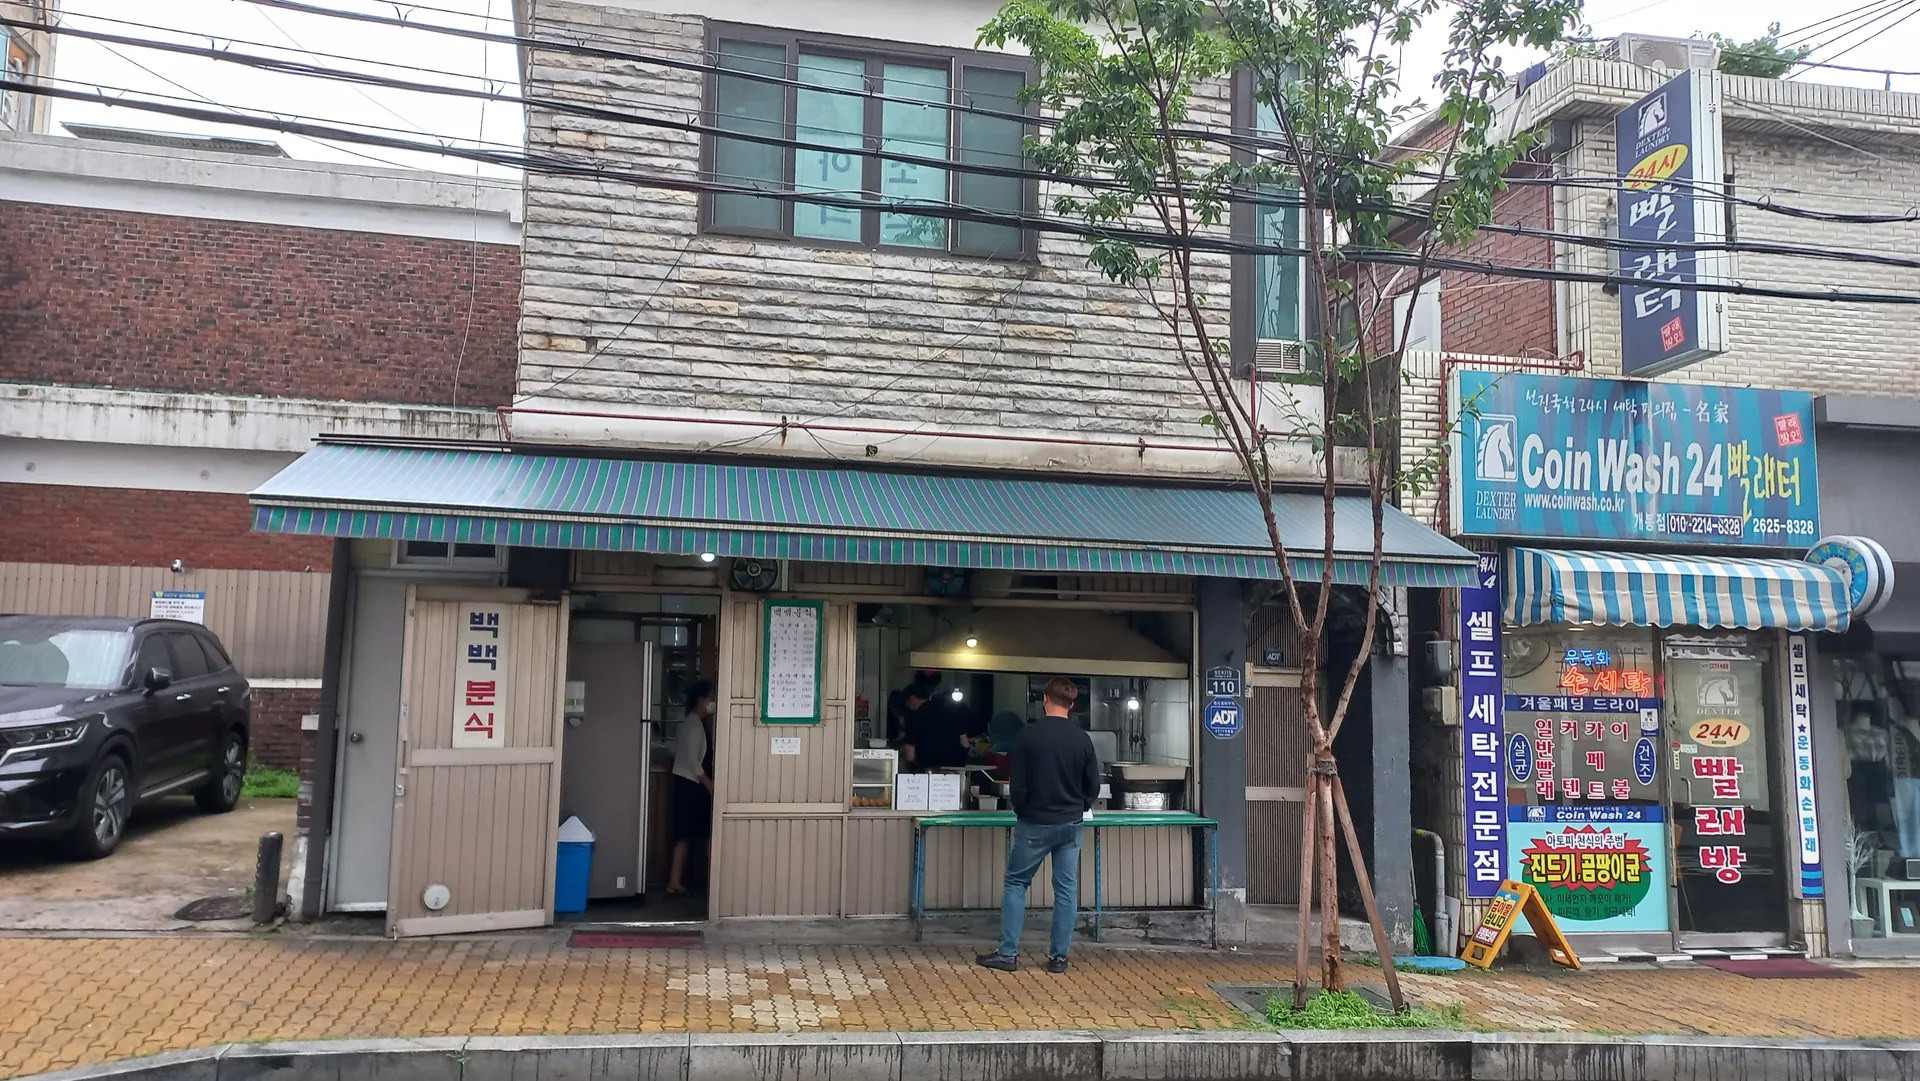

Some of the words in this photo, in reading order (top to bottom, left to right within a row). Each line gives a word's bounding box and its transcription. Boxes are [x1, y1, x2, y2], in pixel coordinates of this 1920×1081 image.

[1635, 133, 1671, 158] LAUNDRY
[1636, 127, 1668, 150] DEXTER
[1579, 399, 1607, 414] 24시
[1613, 399, 1638, 418] 세탁
[1521, 432, 1591, 492] Coin
[1598, 438, 1680, 495] Wash
[1686, 443, 1724, 497] 24
[1727, 440, 1800, 522] 빨래터
[1475, 490, 1517, 508] DEXTER
[1524, 493, 1625, 512] www.coinwash.co.kr
[1475, 507, 1517, 521] LAUNDRY
[1633, 512, 1666, 533] 개봉점
[1752, 518, 1815, 536] 2625-8328
[1266, 653, 1281, 661] ADT
[1564, 649, 1611, 666] 운동화
[1213, 681, 1235, 693] 110
[1561, 667, 1652, 698] 손세탁
[1520, 696, 1584, 711] 겨울패딩
[1593, 699, 1639, 712] 드라이
[1696, 708, 1741, 716] DEXTER
[1211, 710, 1238, 725] ADT
[1695, 723, 1742, 741] 24시
[1513, 741, 1528, 776] 살균
[1535, 719, 1555, 800] 일반빨래
[1638, 745, 1652, 778] 건조
[1556, 811, 1585, 820] Coin
[1590, 811, 1623, 820] Wash
[1626, 811, 1641, 820] 24
[1692, 757, 1746, 884] 빨래방
[1605, 835, 1625, 848] 주범
